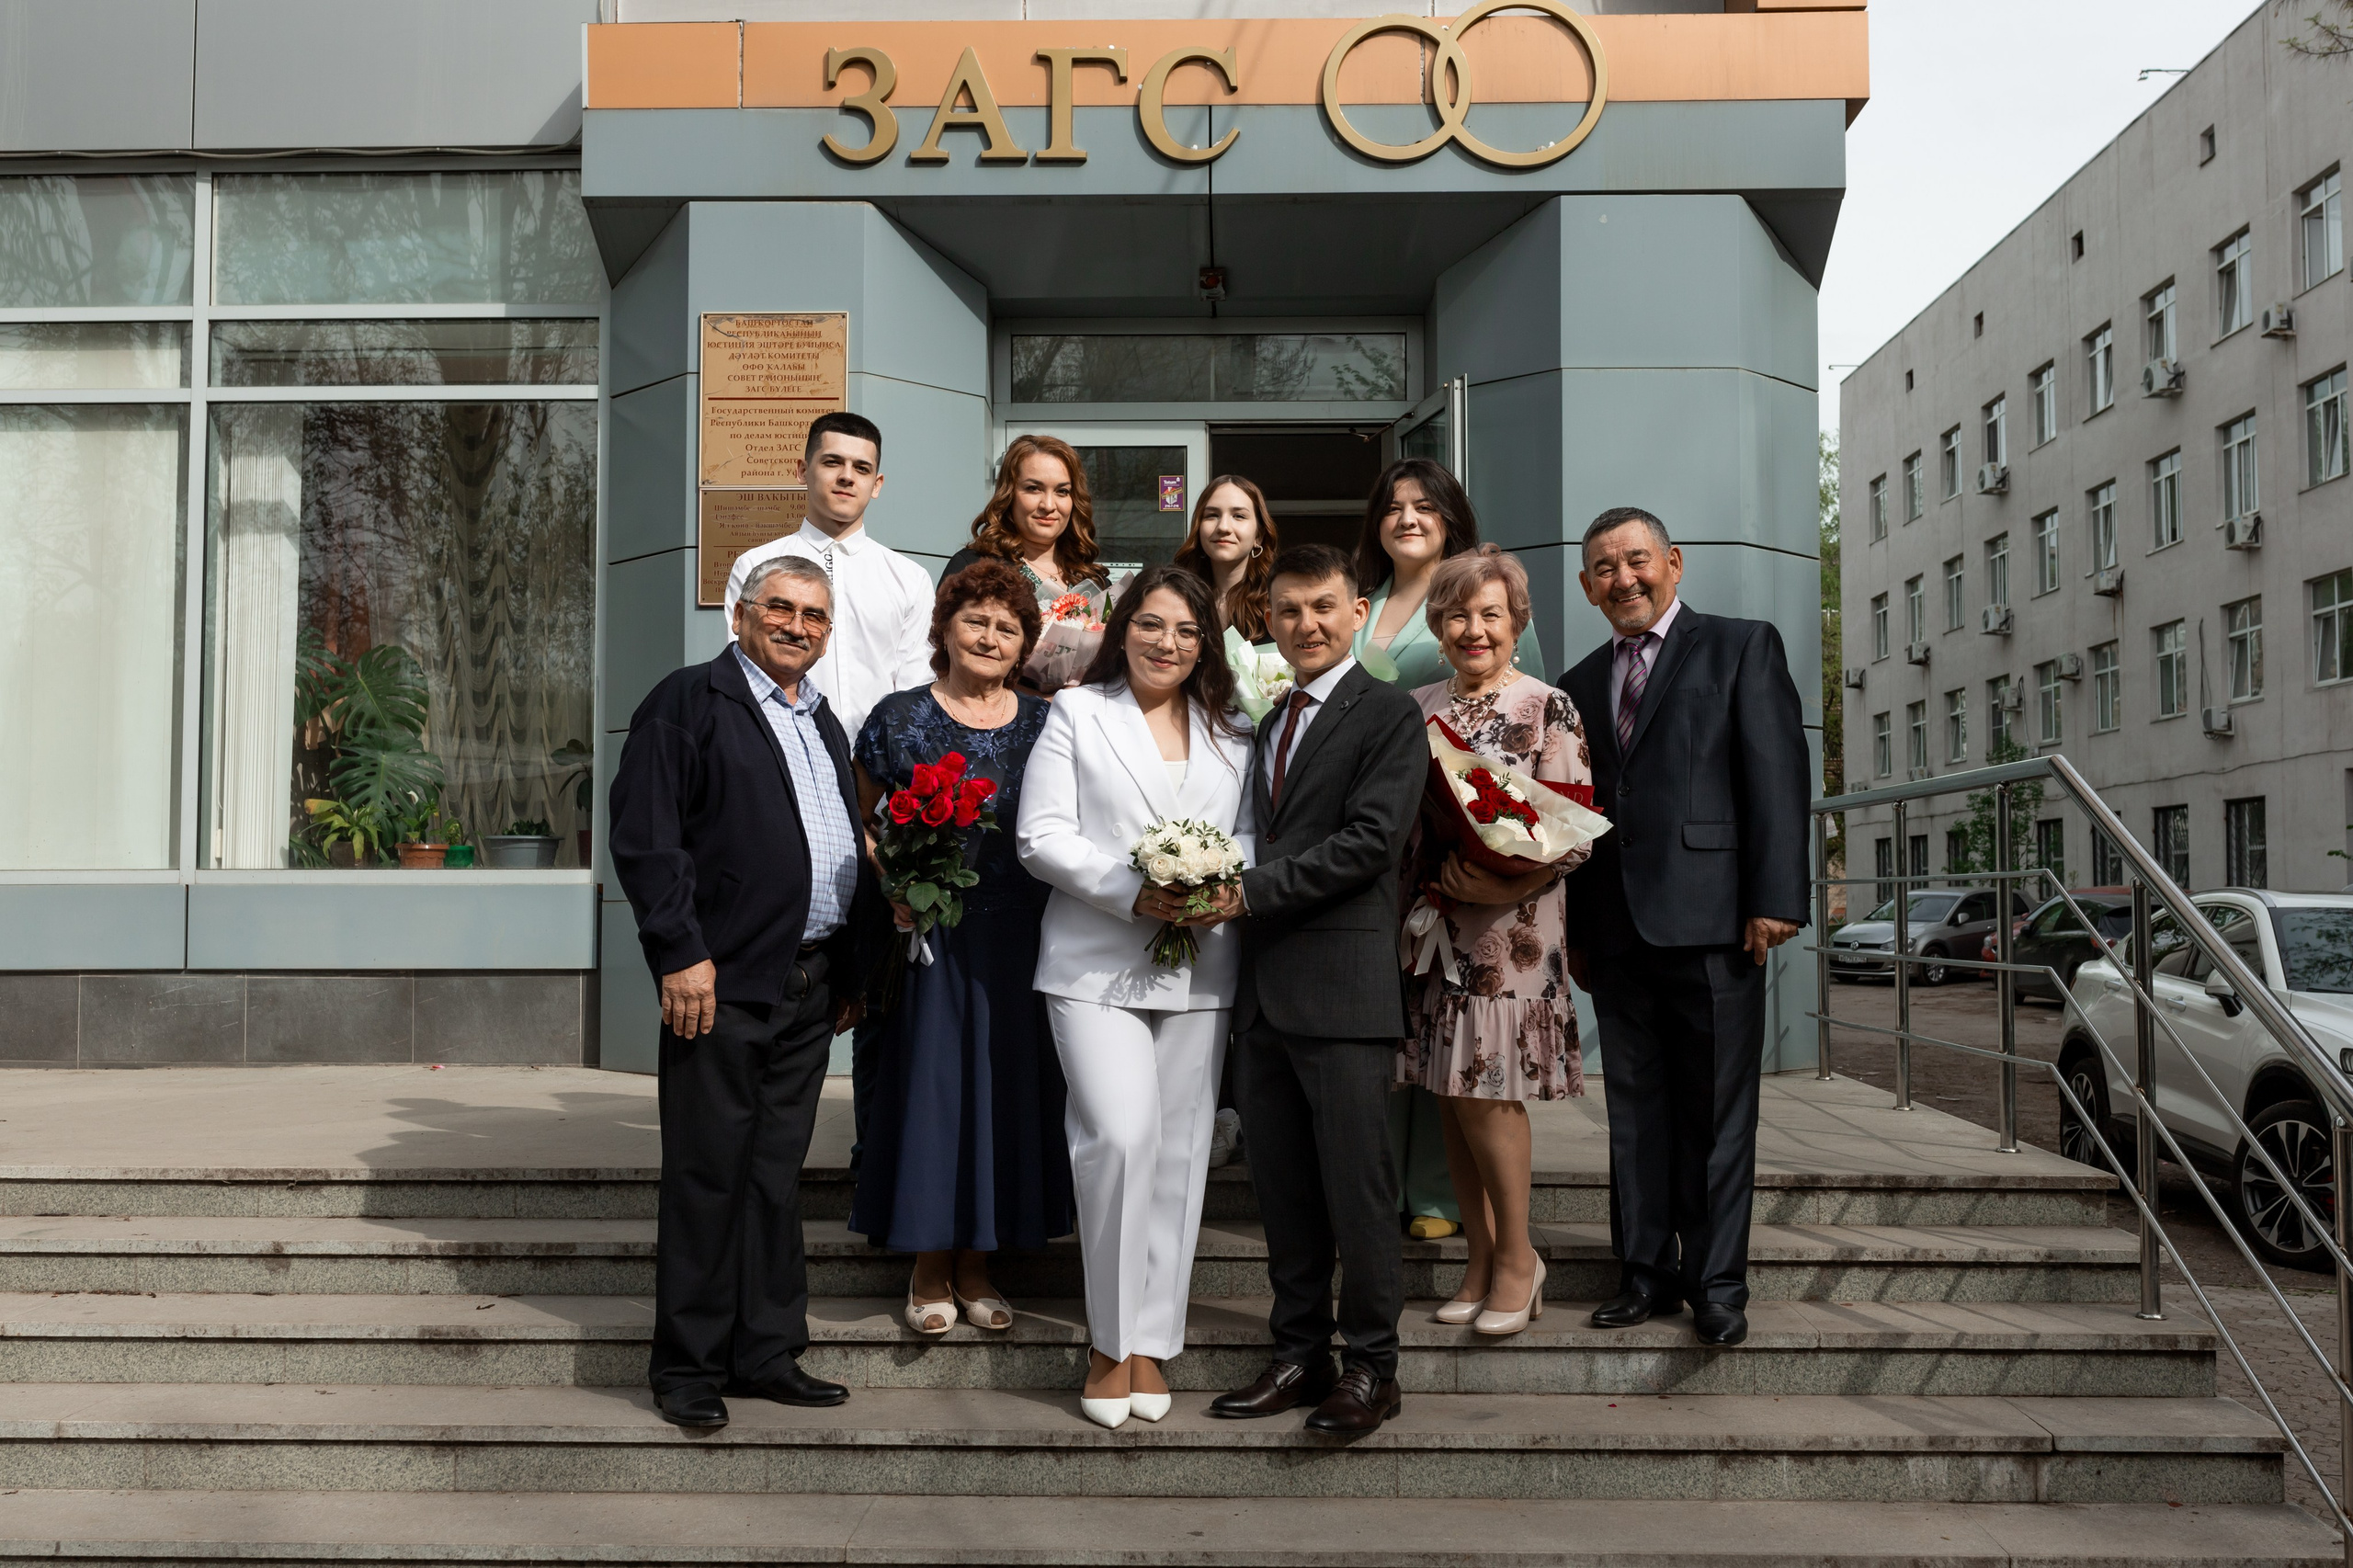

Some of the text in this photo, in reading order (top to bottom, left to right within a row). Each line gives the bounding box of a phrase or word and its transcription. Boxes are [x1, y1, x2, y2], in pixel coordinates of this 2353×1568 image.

[822, 46, 1240, 164] ЗАГС
[711, 406, 793, 416] Государственный
[710, 419, 766, 429] Республики
[744, 432, 772, 440] делам
[745, 443, 801, 453] Отдел ЗАГС
[746, 456, 799, 464] Советского
[741, 469, 775, 479] района
[735, 493, 754, 502] ЭШ
